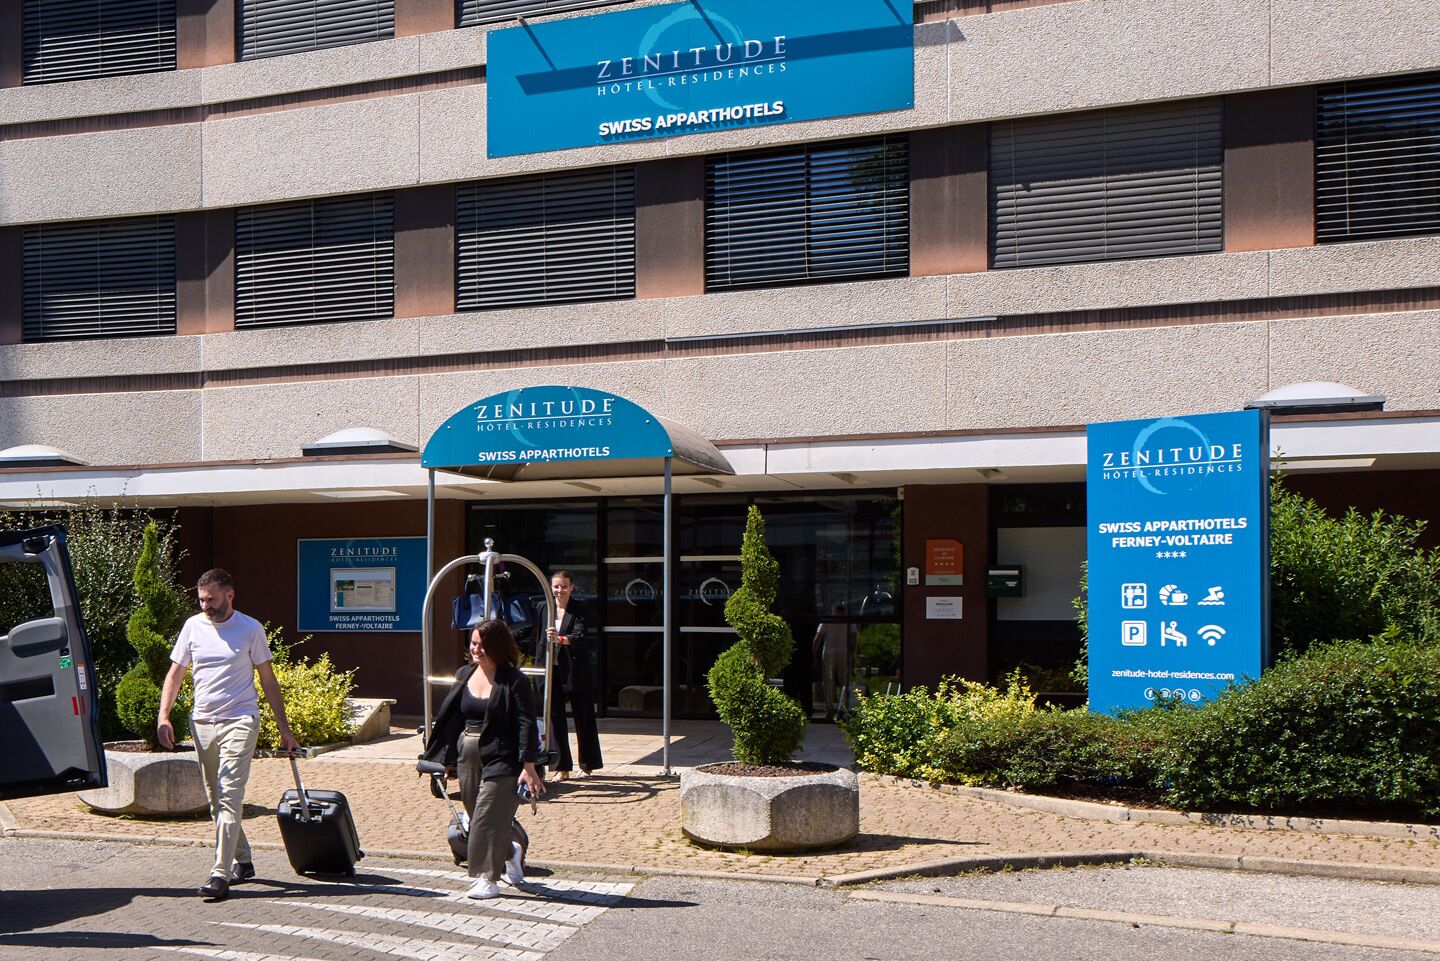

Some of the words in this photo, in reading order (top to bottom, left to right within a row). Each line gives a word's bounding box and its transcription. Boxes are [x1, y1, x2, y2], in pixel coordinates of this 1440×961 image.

[597, 34, 786, 79] ZENITUDE
[597, 62, 787, 96] HÔTEL-RÉSIDENCES
[598, 116, 652, 136] SWISS
[655, 100, 784, 129] APPARTHOTELS
[476, 398, 613, 419] ZENITUDE
[478, 450, 516, 462] SWISS
[518, 446, 610, 460] APPARTHOTELS
[1102, 443, 1243, 467] ZENITUDE
[1098, 521, 1141, 534] SWISS
[1144, 517, 1248, 532] APPARTHOTELS
[1112, 533, 1233, 548] FERNEY-VOLTAIRE
[331, 546, 398, 556] ZENITUDE
[1111, 669, 1235, 680] zenitude-hotel-residences.com
